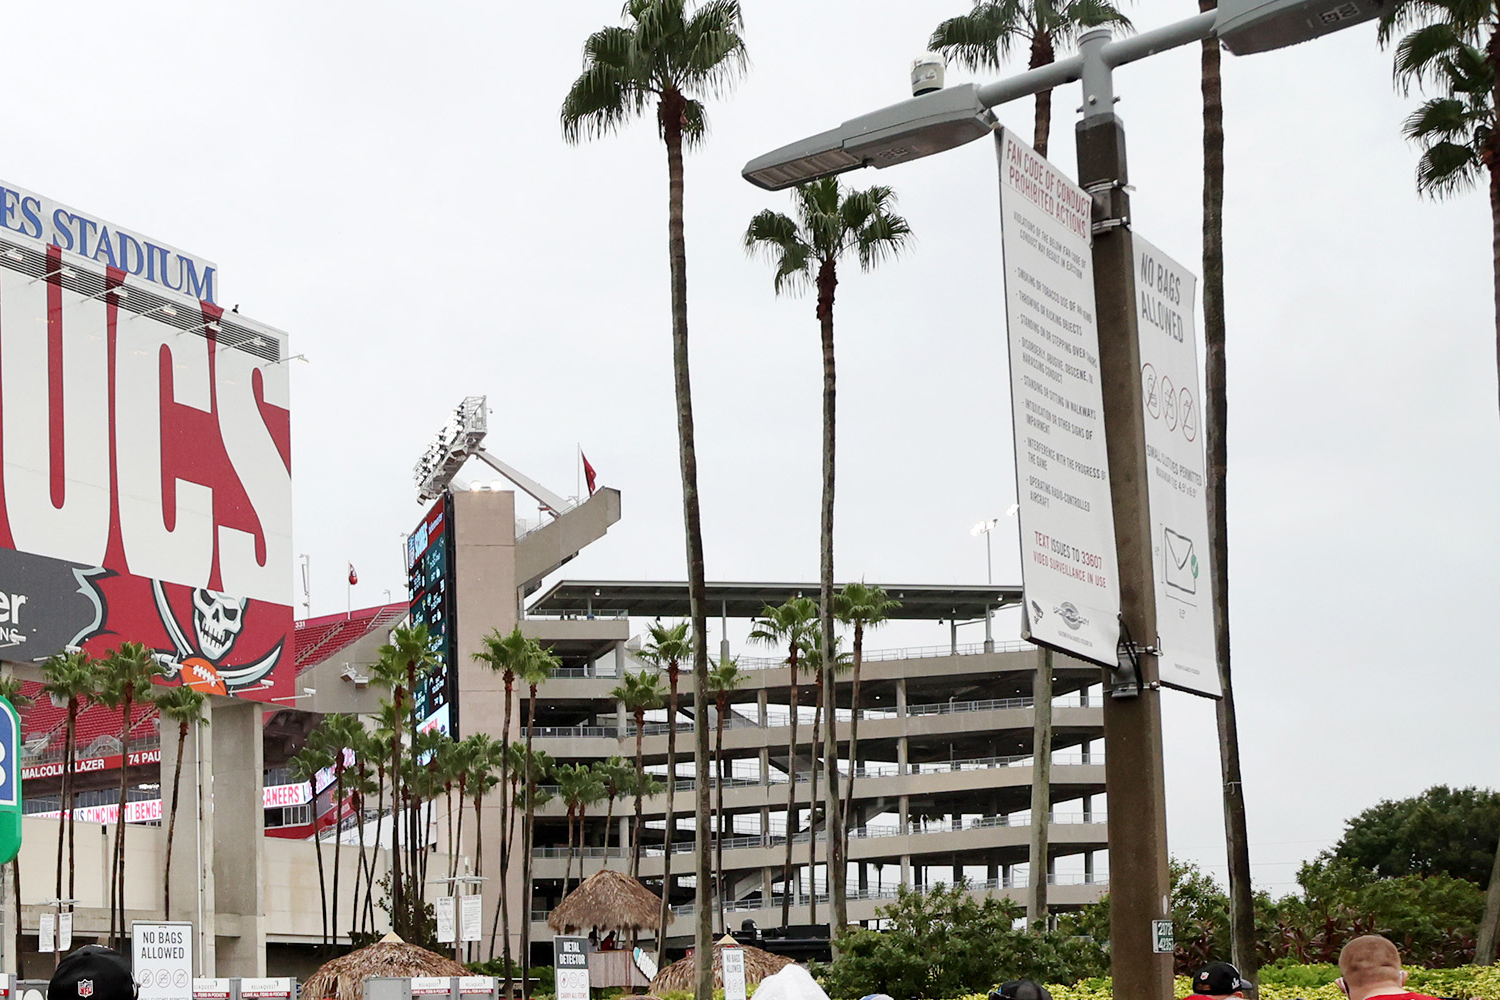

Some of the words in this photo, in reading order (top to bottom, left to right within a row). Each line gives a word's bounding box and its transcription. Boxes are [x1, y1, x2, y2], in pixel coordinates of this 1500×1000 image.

[1007, 140, 1022, 168] FAN
[1024, 152, 1043, 185] CODE
[1046, 170, 1055, 192] OF
[1057, 179, 1090, 219] CONDUCT
[1009, 165, 1054, 215] PROHIBITED
[1056, 201, 1086, 239] ACTIONS
[52, 209, 217, 304] STADIUM
[1141, 252, 1154, 288] NO
[1157, 263, 1180, 306] BAGS
[1141, 290, 1183, 343] ALLOWED
[1034, 531, 1049, 550] TEXT
[1051, 538, 1070, 558] ISSUES
[1072, 547, 1080, 562] TO
[1081, 551, 1102, 570] 33607
[1033, 551, 1048, 567] VIDEO
[1049, 558, 1085, 582] SURVEILLANCE
[1087, 573, 1094, 584] IN
[1095, 576, 1106, 588] USE
[128, 754, 140, 766] 74
[87, 804, 133, 823] CINCINNTI
[141, 947, 185, 960] ALLOWED
[142, 931, 155, 944] NO
[158, 931, 183, 944] BAGS
[563, 941, 580, 953] METAL
[559, 953, 586, 965] DETECTOR
